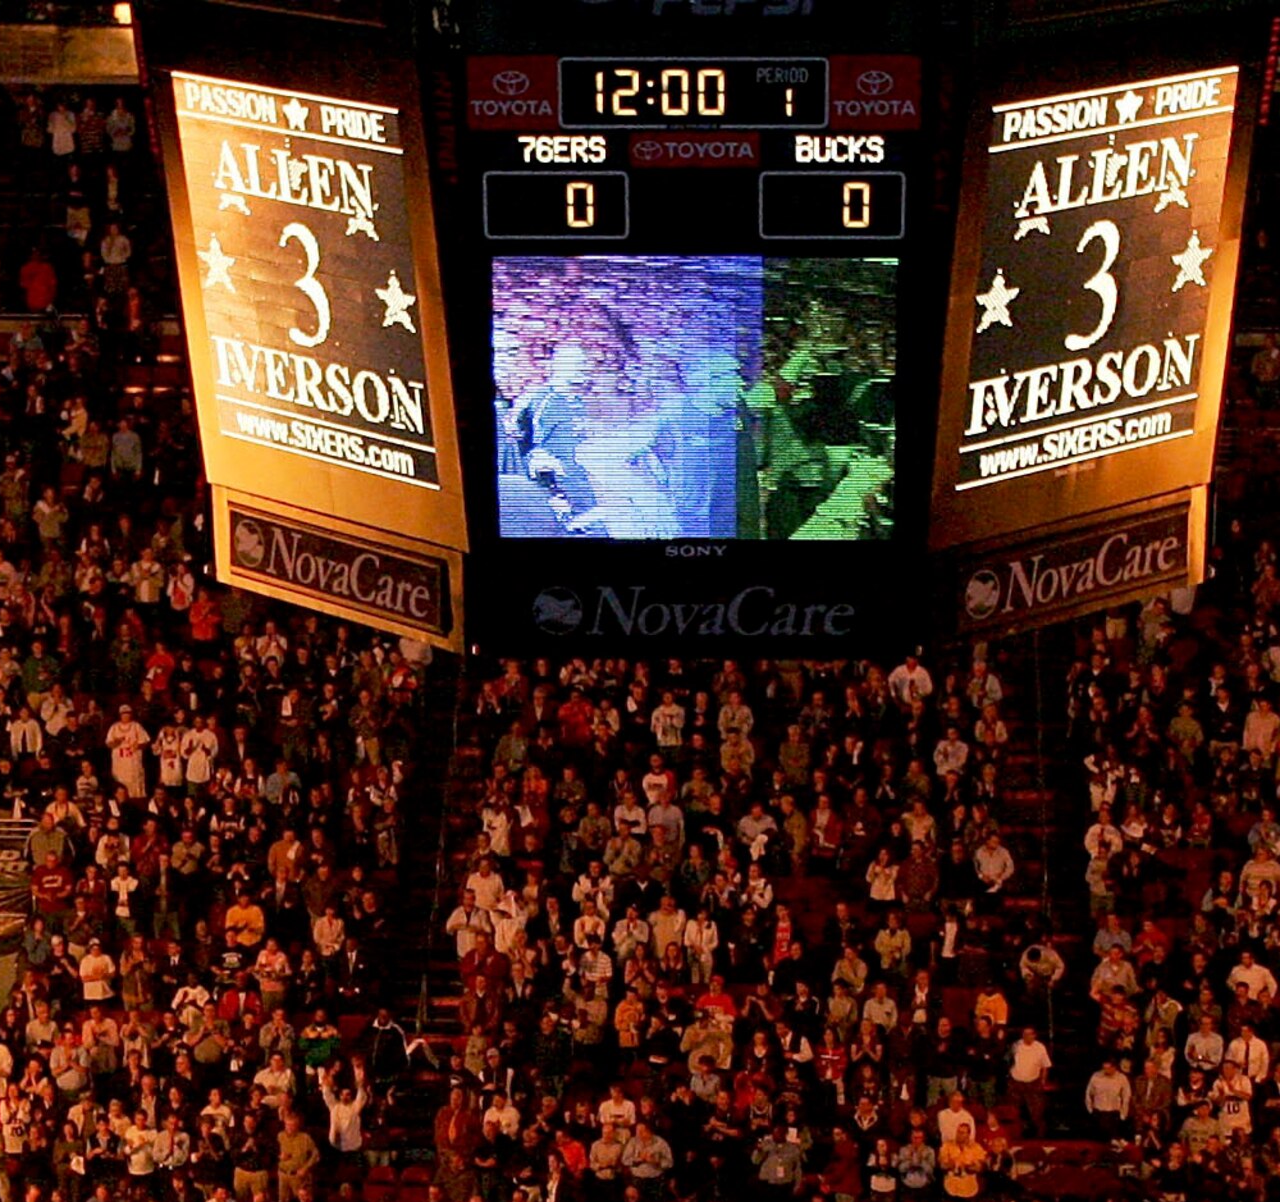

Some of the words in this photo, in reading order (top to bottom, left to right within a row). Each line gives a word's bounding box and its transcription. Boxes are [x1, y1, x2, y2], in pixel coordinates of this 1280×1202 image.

[594, 67, 727, 117] 12:00
[755, 67, 809, 84] PERIOD
[783, 86, 794, 118] 1
[183, 81, 278, 124] PASSION
[320, 104, 387, 143] PRIDE
[471, 100, 554, 117] TOYOTA
[832, 100, 917, 117] TOYOTA
[1002, 95, 1108, 142] PASSION
[1153, 77, 1222, 115] PRIDE
[518, 135, 607, 163] 76ERS
[663, 140, 756, 160] TOYOTA
[794, 135, 886, 163] BUCKS
[1014, 132, 1200, 219] ALLEN
[213, 139, 377, 218] ALLEN
[565, 181, 595, 229] 0
[842, 181, 872, 229] 0
[278, 222, 332, 348] 3
[1065, 219, 1122, 351] 3
[211, 335, 426, 435] IVERSON
[963, 332, 1200, 437] IVERSON
[235, 411, 416, 477] www.SIXERS.com
[978, 412, 1172, 477] www.SIXERS.com
[269, 527, 431, 619] NovaCare
[664, 544, 728, 558] SONY
[1001, 533, 1179, 614] NovaCare
[585, 584, 857, 637] NovaCare
